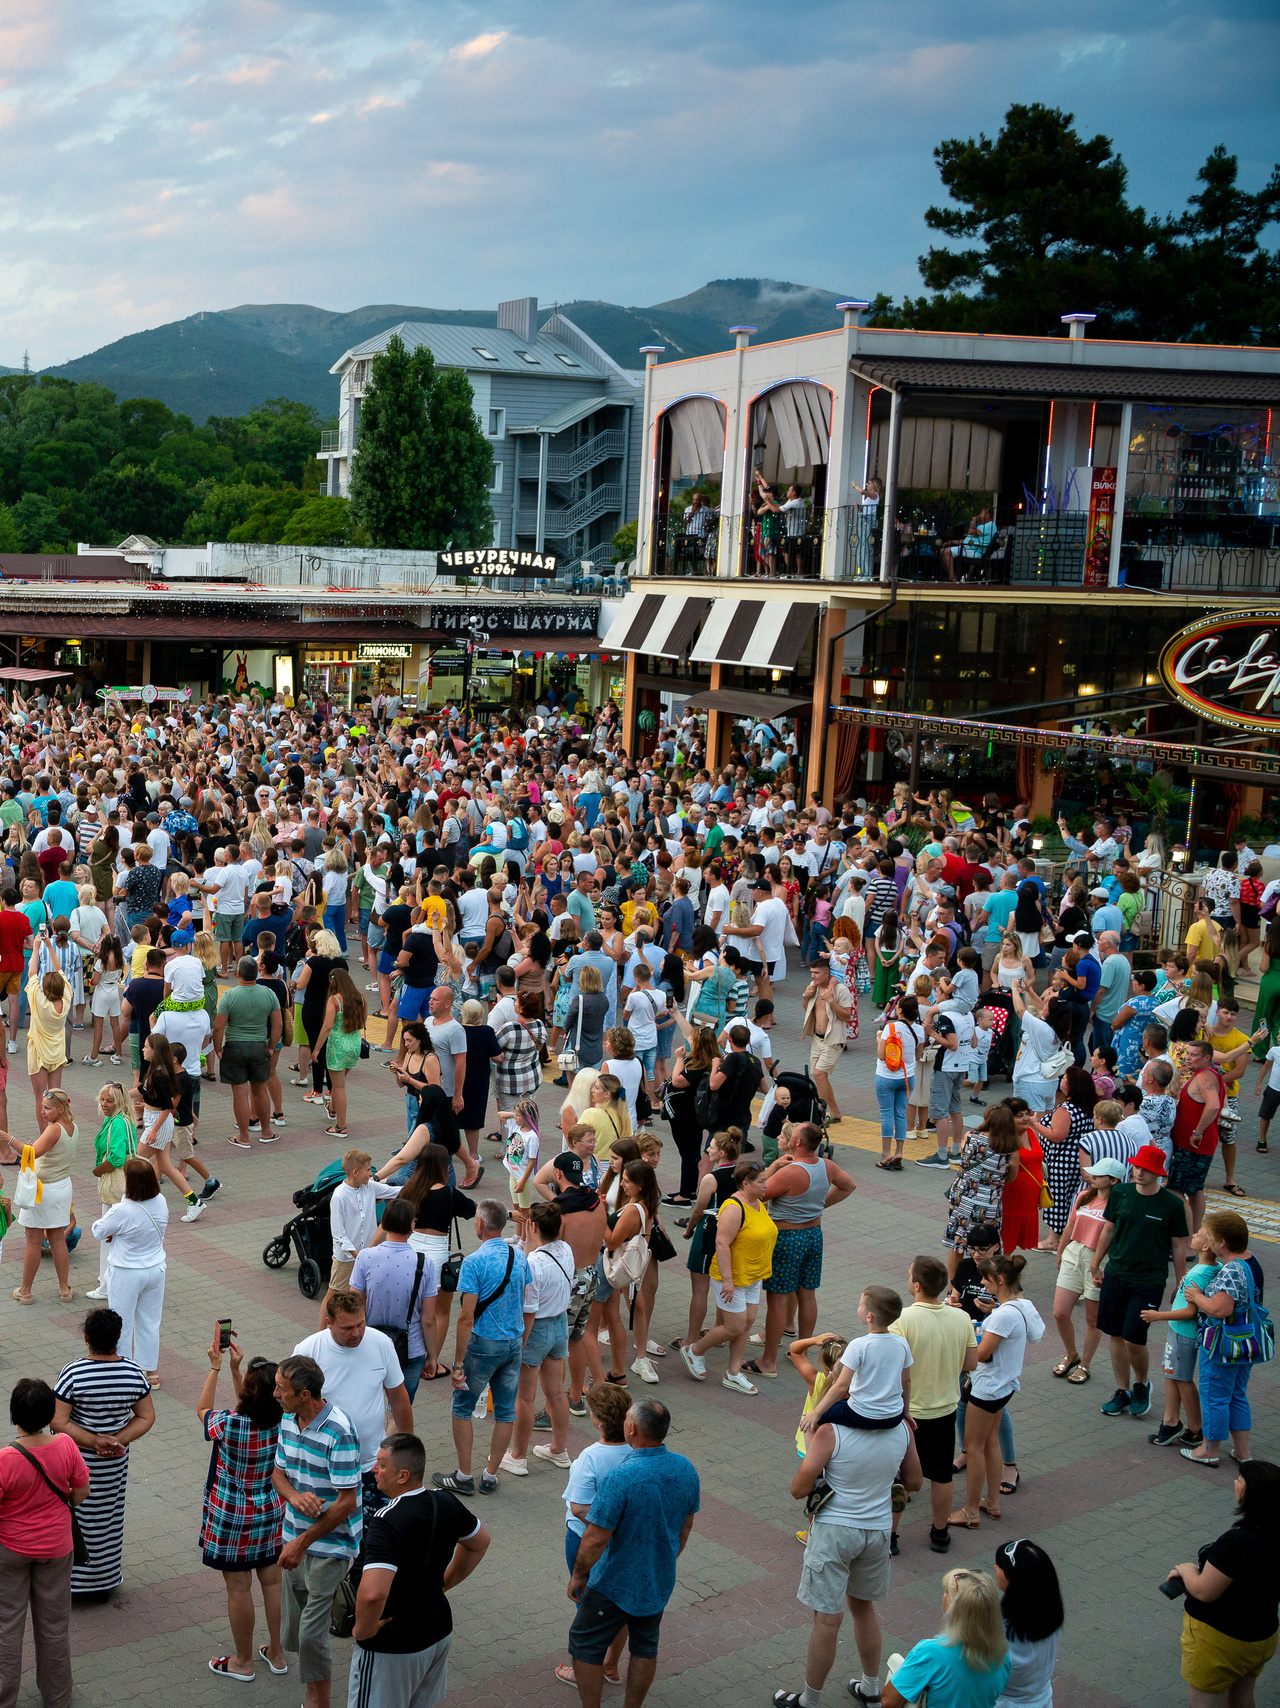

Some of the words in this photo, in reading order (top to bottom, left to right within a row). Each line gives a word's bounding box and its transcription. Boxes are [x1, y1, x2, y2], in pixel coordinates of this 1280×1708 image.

[441, 550, 556, 571] ЧЕБУРЕЧНАЯ
[481, 563, 517, 575] 1996г
[434, 614, 499, 629] ГИРОС
[513, 613, 593, 630] ШАУРМА
[1182, 611, 1251, 636] ESPRESSO
[1176, 695, 1240, 728] ESPRESSO
